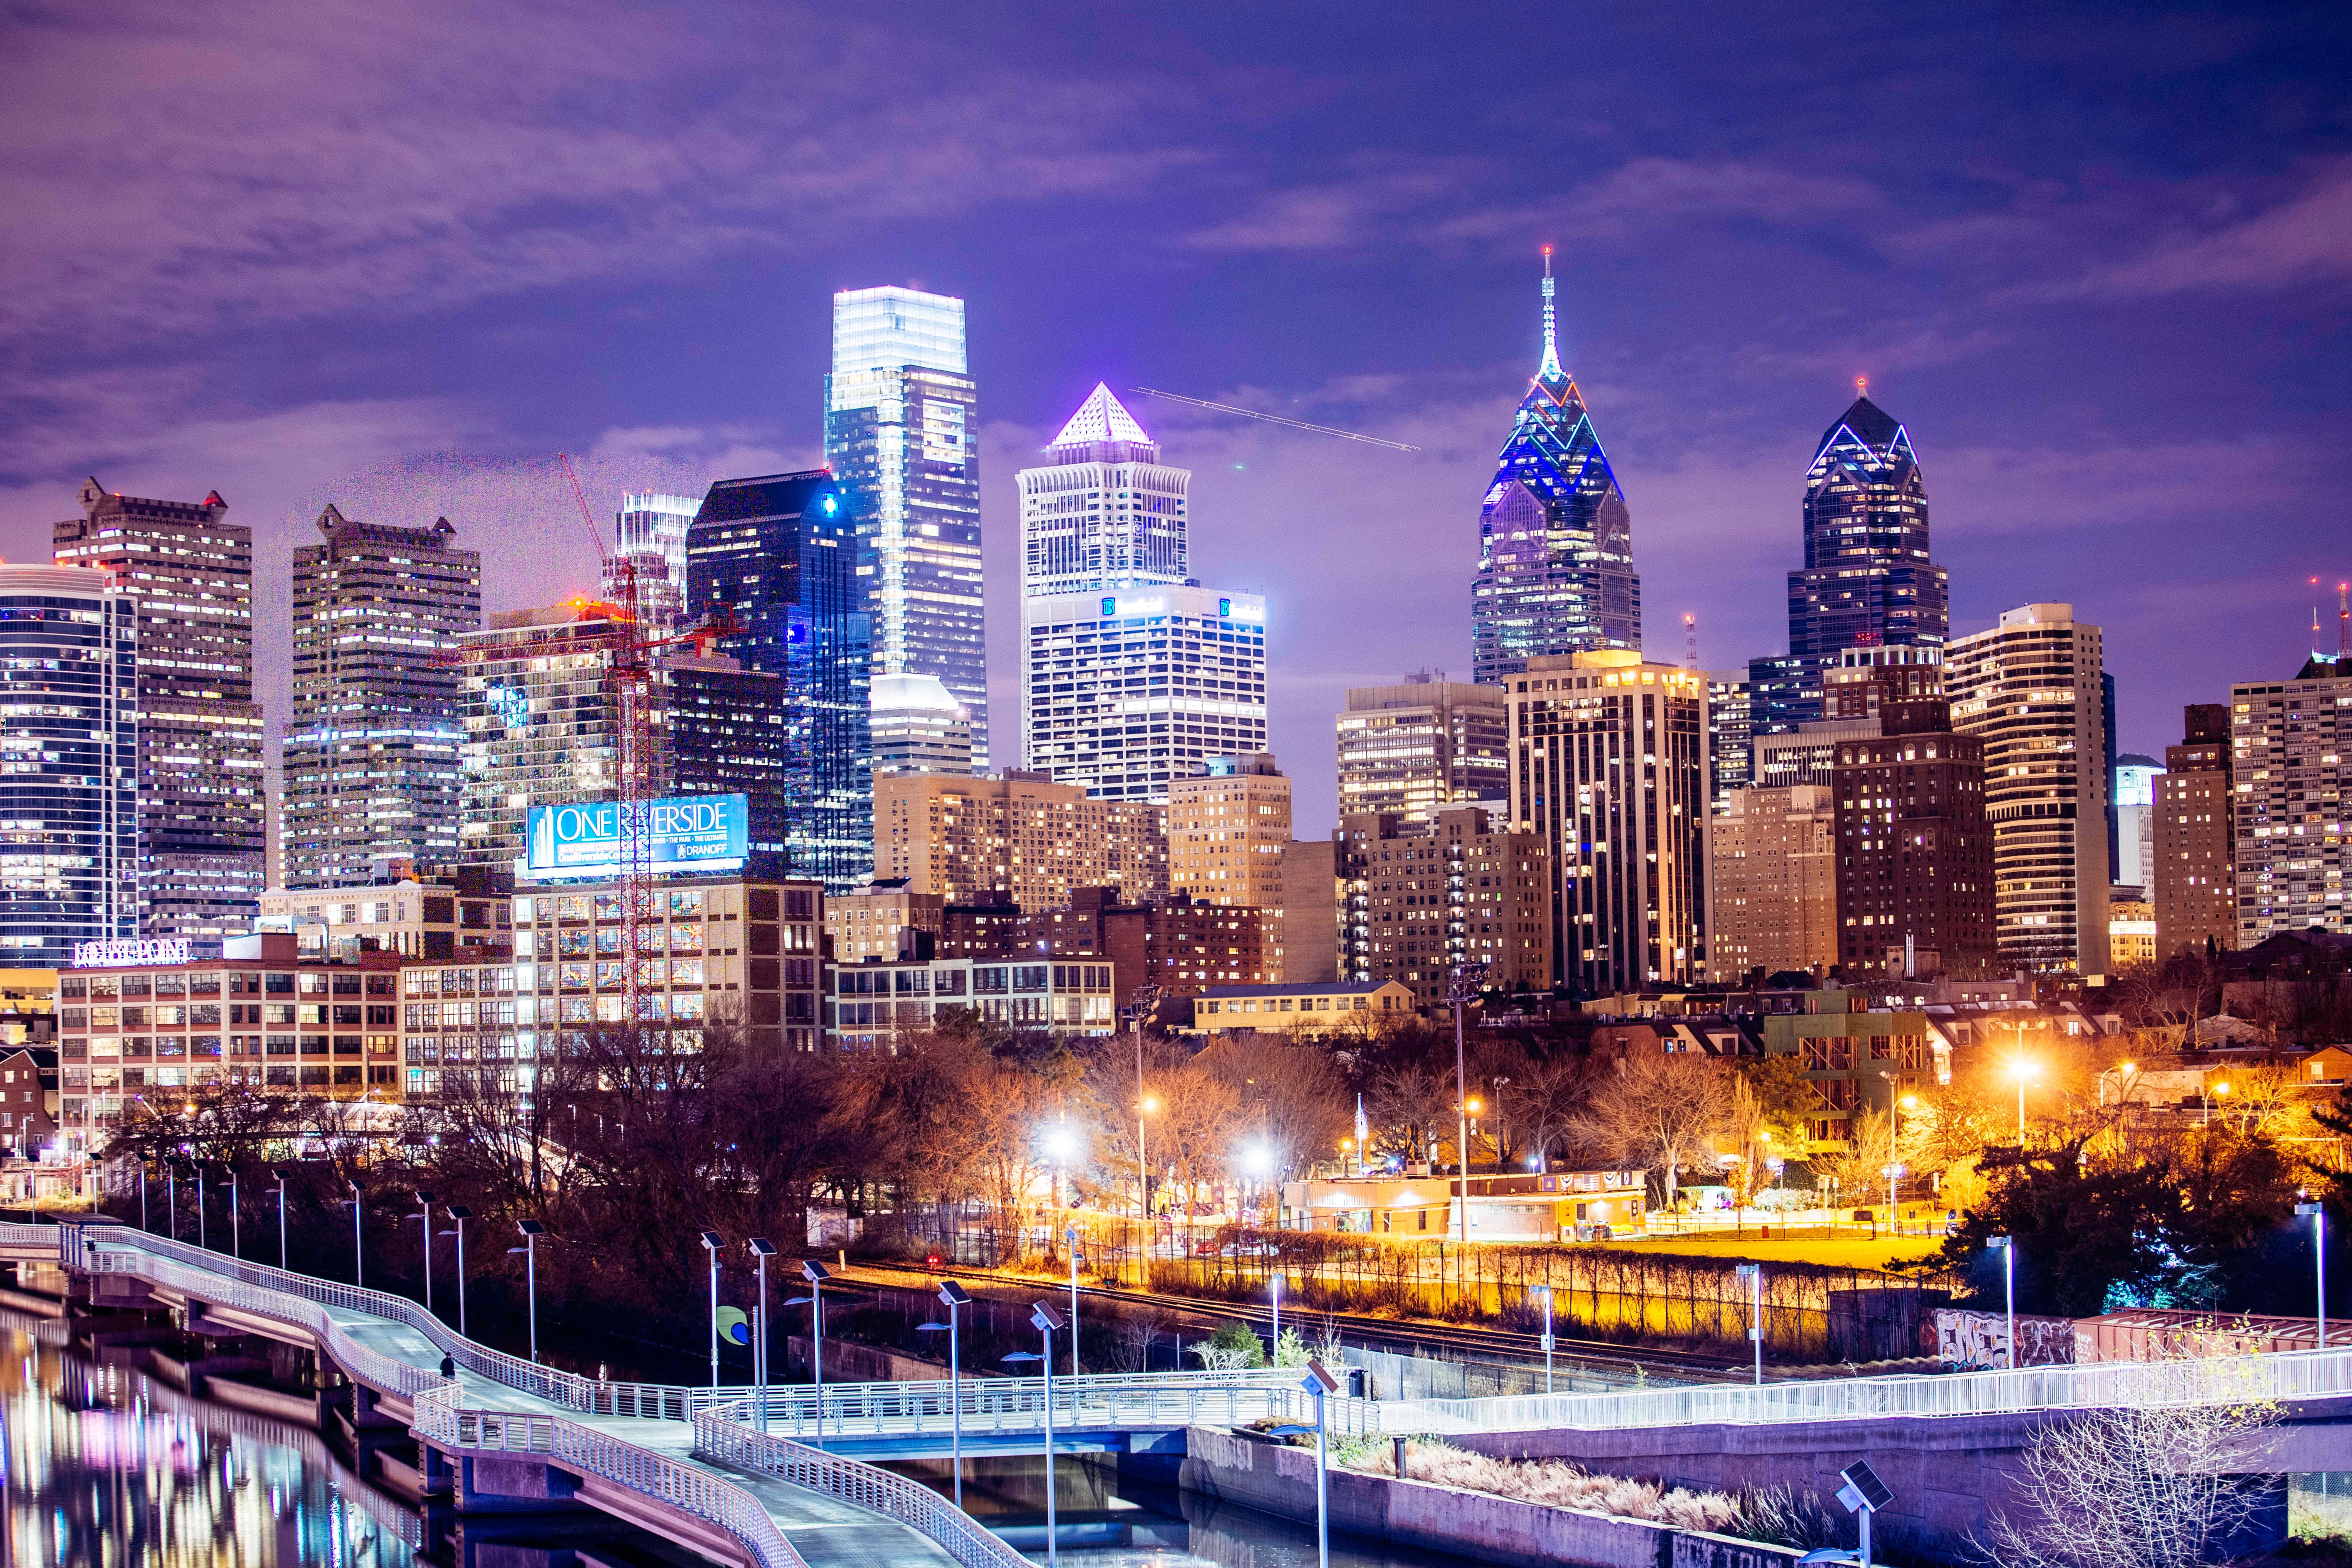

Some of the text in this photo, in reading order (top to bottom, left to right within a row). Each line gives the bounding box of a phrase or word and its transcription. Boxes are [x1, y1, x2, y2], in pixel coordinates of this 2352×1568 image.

[557, 802, 727, 841] ONE RIVERSIDE
[595, 839, 643, 851] CONSTR
[686, 844, 727, 856] DRANOFF
